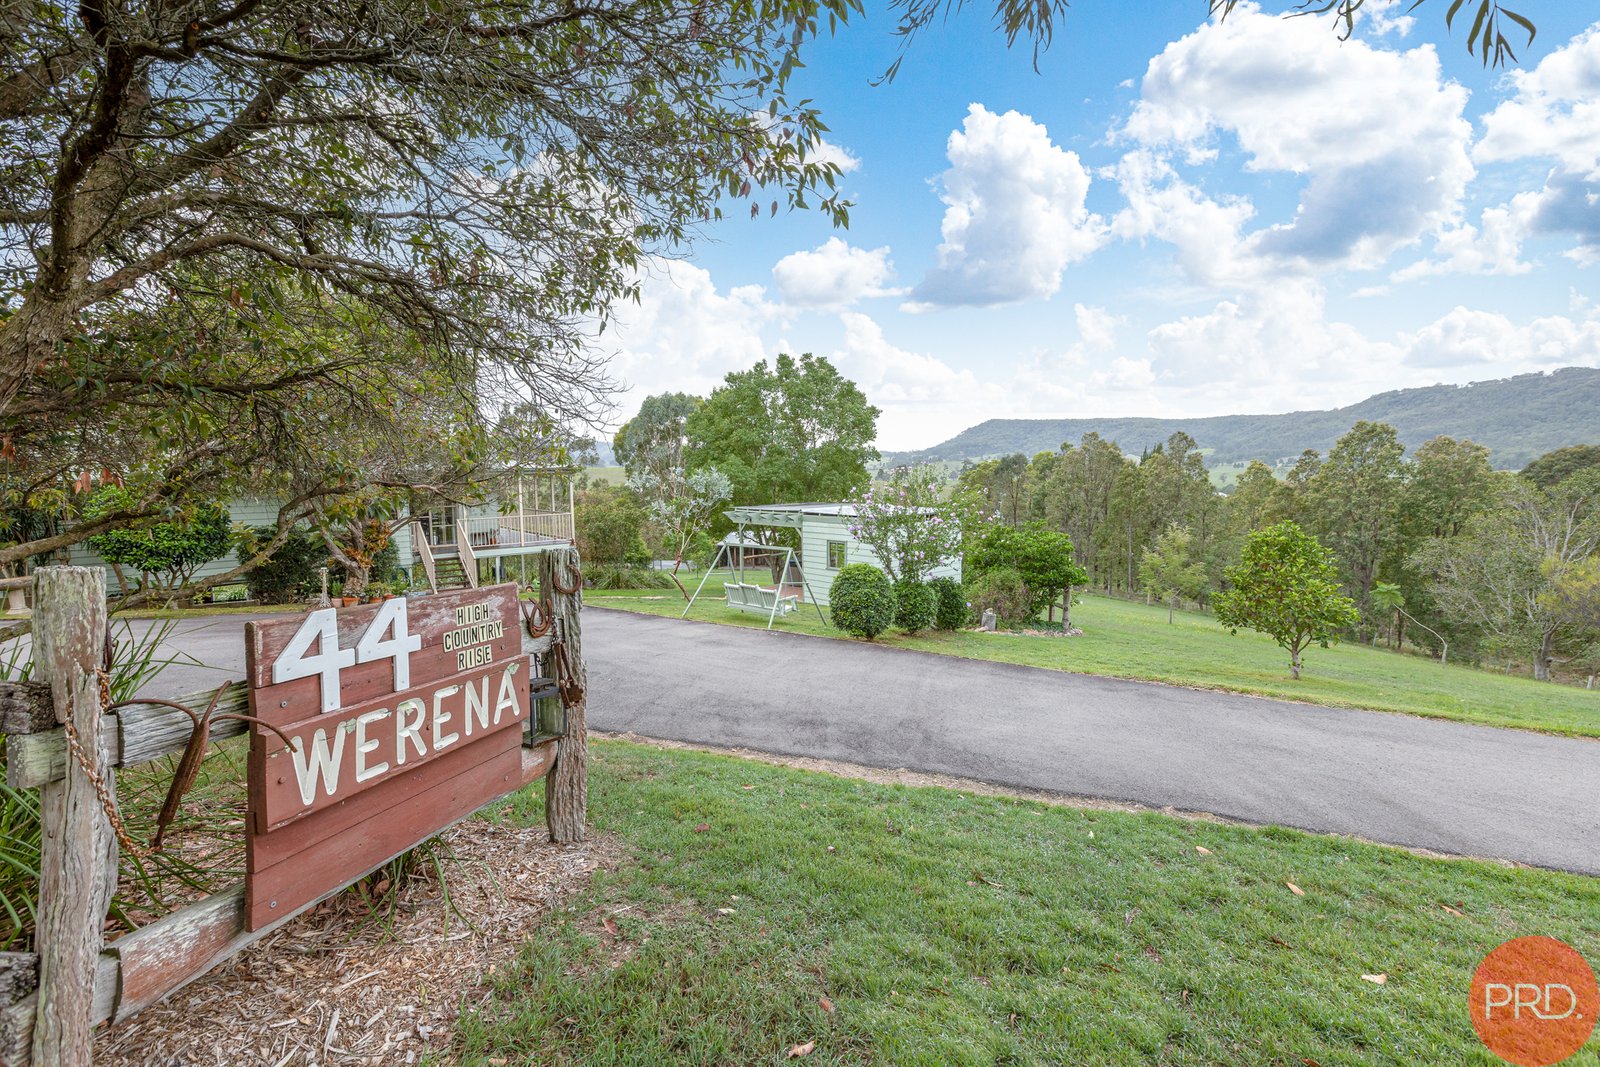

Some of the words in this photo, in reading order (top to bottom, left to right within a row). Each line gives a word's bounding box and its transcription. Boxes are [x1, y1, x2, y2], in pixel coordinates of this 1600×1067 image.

[456, 603, 490, 626] HIGH
[444, 620, 502, 651] COUNTRY
[272, 597, 421, 713] 44
[457, 645, 492, 670] RISE
[291, 668, 520, 806] WERENA
